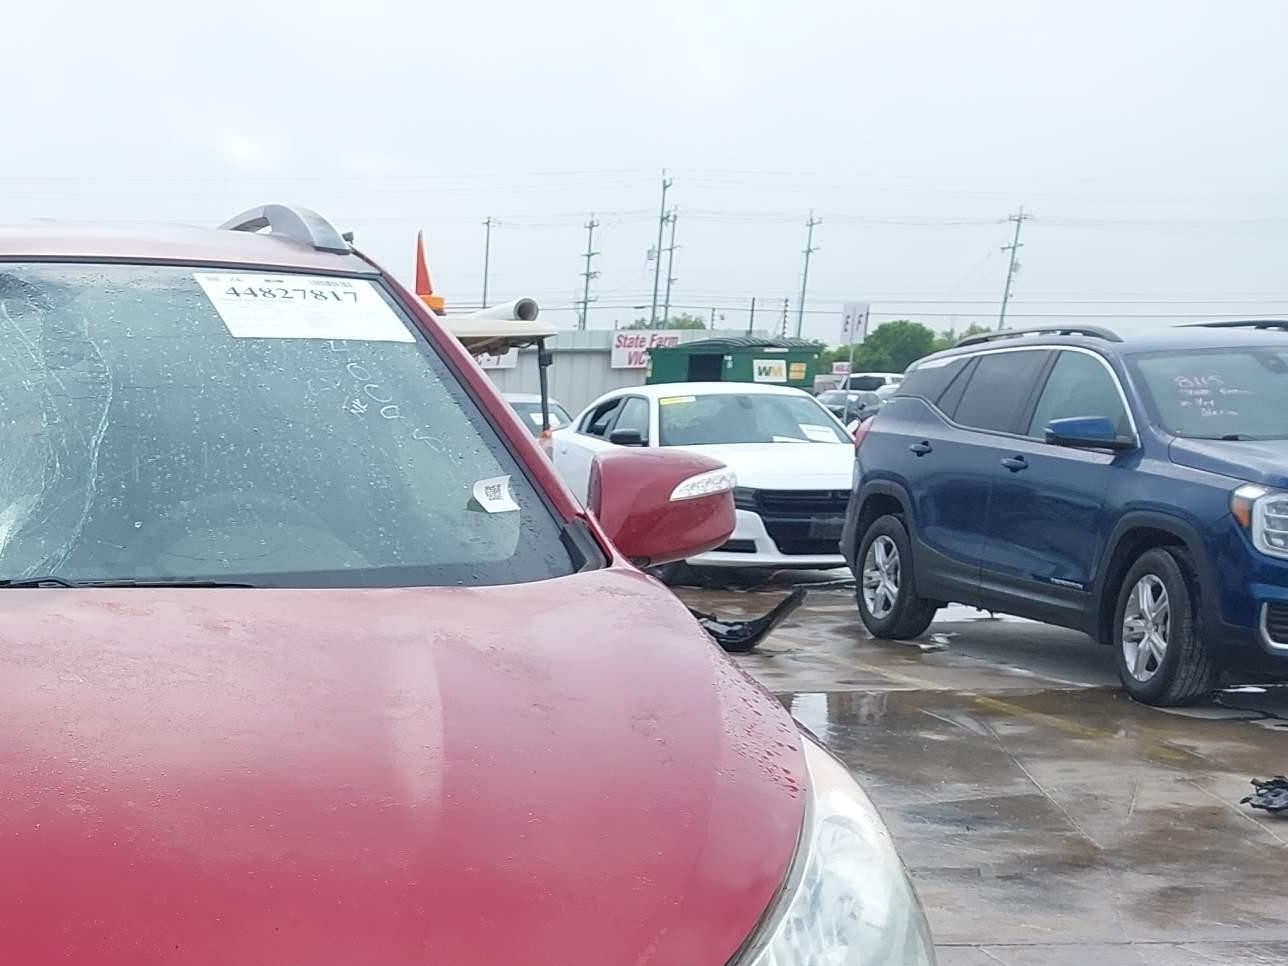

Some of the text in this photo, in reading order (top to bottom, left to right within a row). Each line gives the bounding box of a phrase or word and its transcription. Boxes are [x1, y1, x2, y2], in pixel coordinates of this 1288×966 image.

[224, 285, 358, 303] 44827817
[615, 334, 679, 348] State Farm
